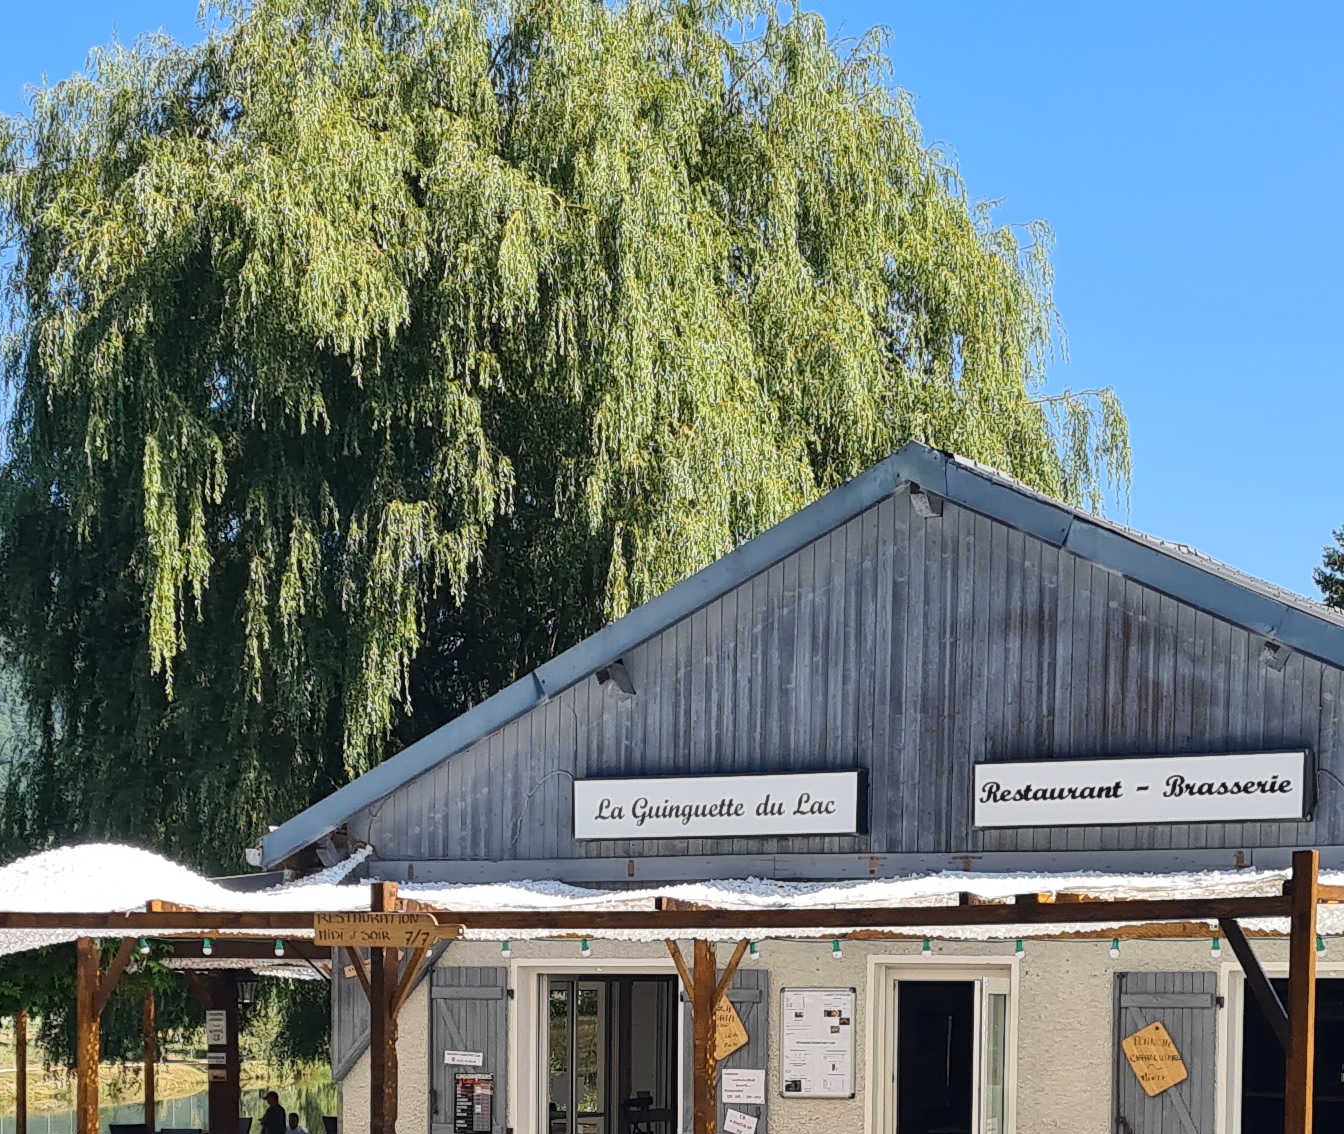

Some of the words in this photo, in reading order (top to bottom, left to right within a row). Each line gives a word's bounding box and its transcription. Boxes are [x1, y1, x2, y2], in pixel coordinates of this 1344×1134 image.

[979, 780, 1123, 804] Restaurant
[1162, 773, 1293, 798] Brasserie
[594, 797, 625, 822] La
[631, 797, 746, 826] Guinguette
[755, 793, 786, 818] du
[792, 792, 837, 817] Lac
[316, 913, 420, 925] RESTAURATION
[360, 929, 391, 942] SOIR
[404, 928, 431, 946] 7/7
